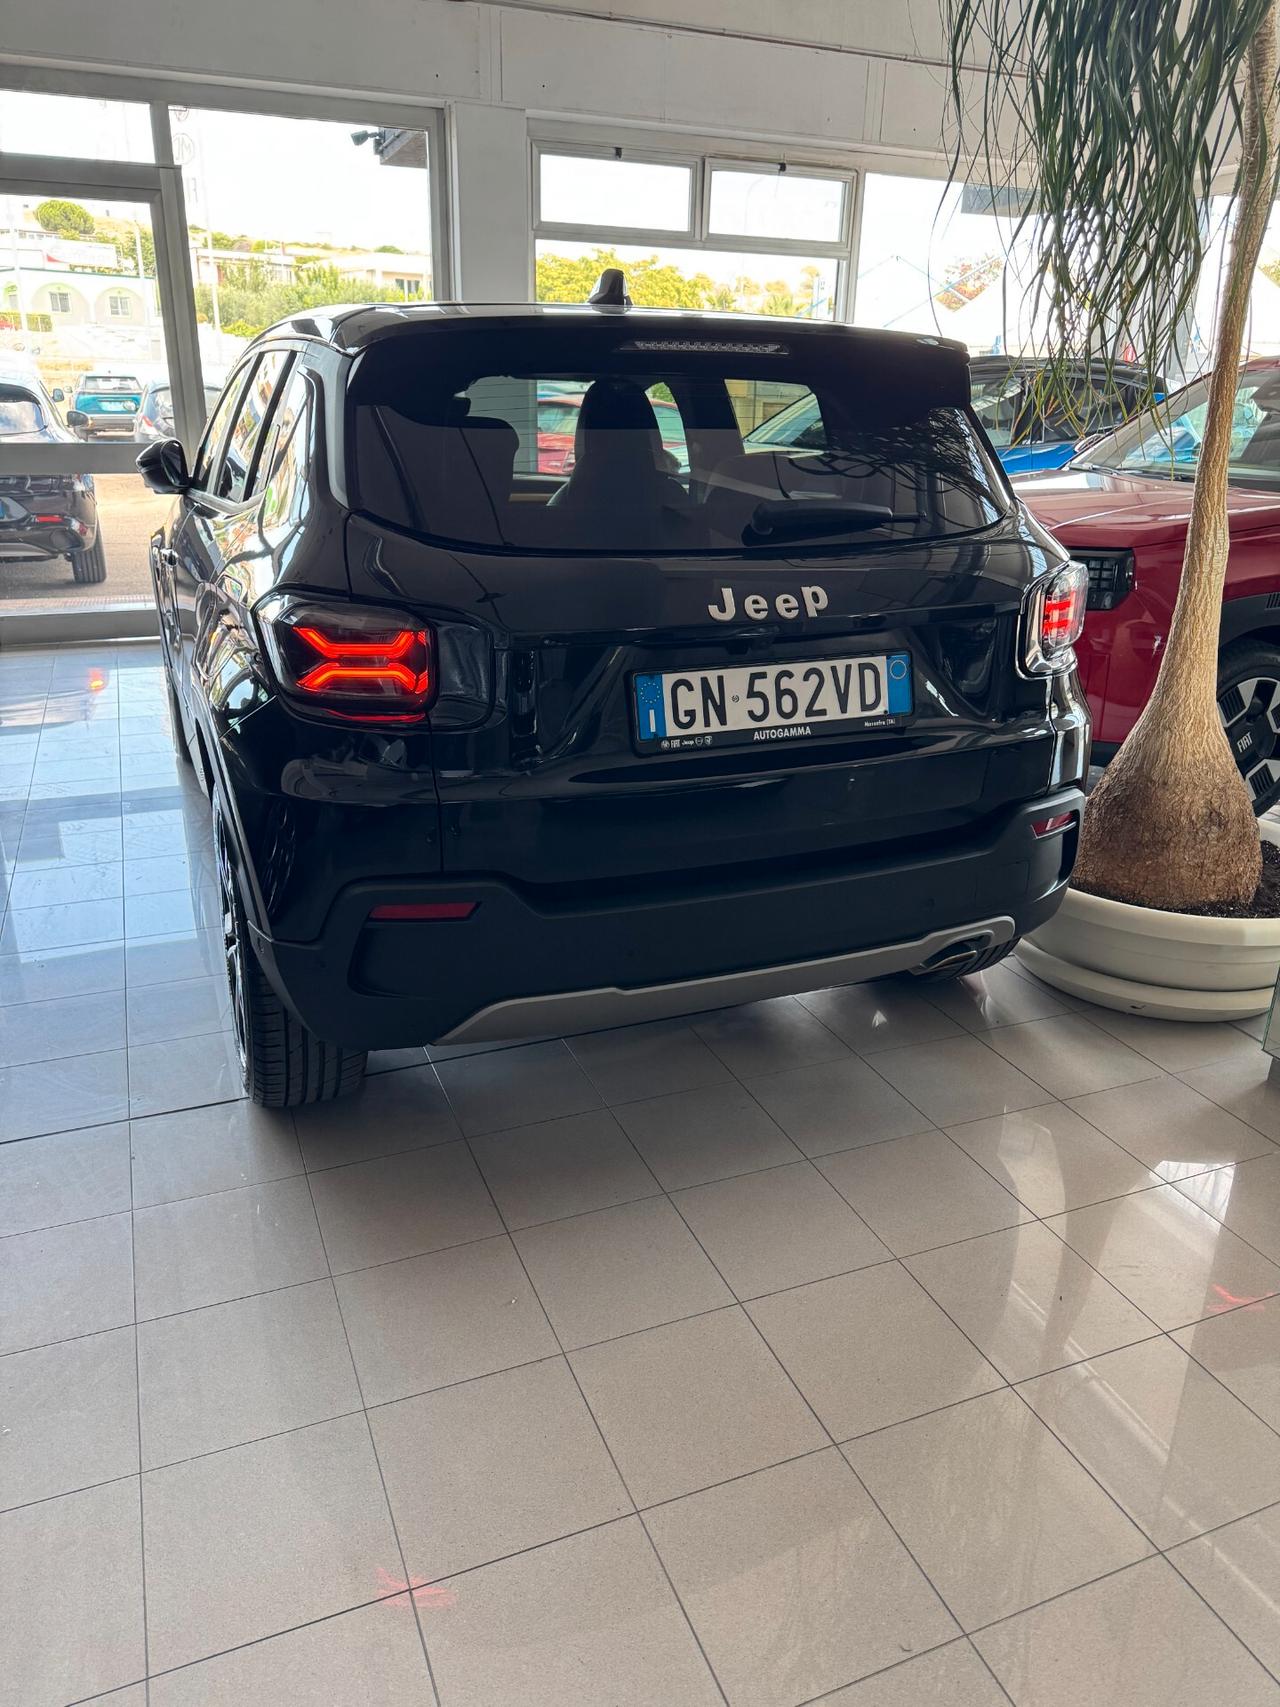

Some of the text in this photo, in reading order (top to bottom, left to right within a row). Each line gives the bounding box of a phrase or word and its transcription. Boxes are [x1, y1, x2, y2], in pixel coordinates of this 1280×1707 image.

[707, 585, 829, 621] Jeep
[670, 662, 882, 730] GN 562VD
[649, 709, 656, 733] I
[753, 725, 812, 741] AUTOGAMMA
[1236, 731, 1253, 753] FIAT
